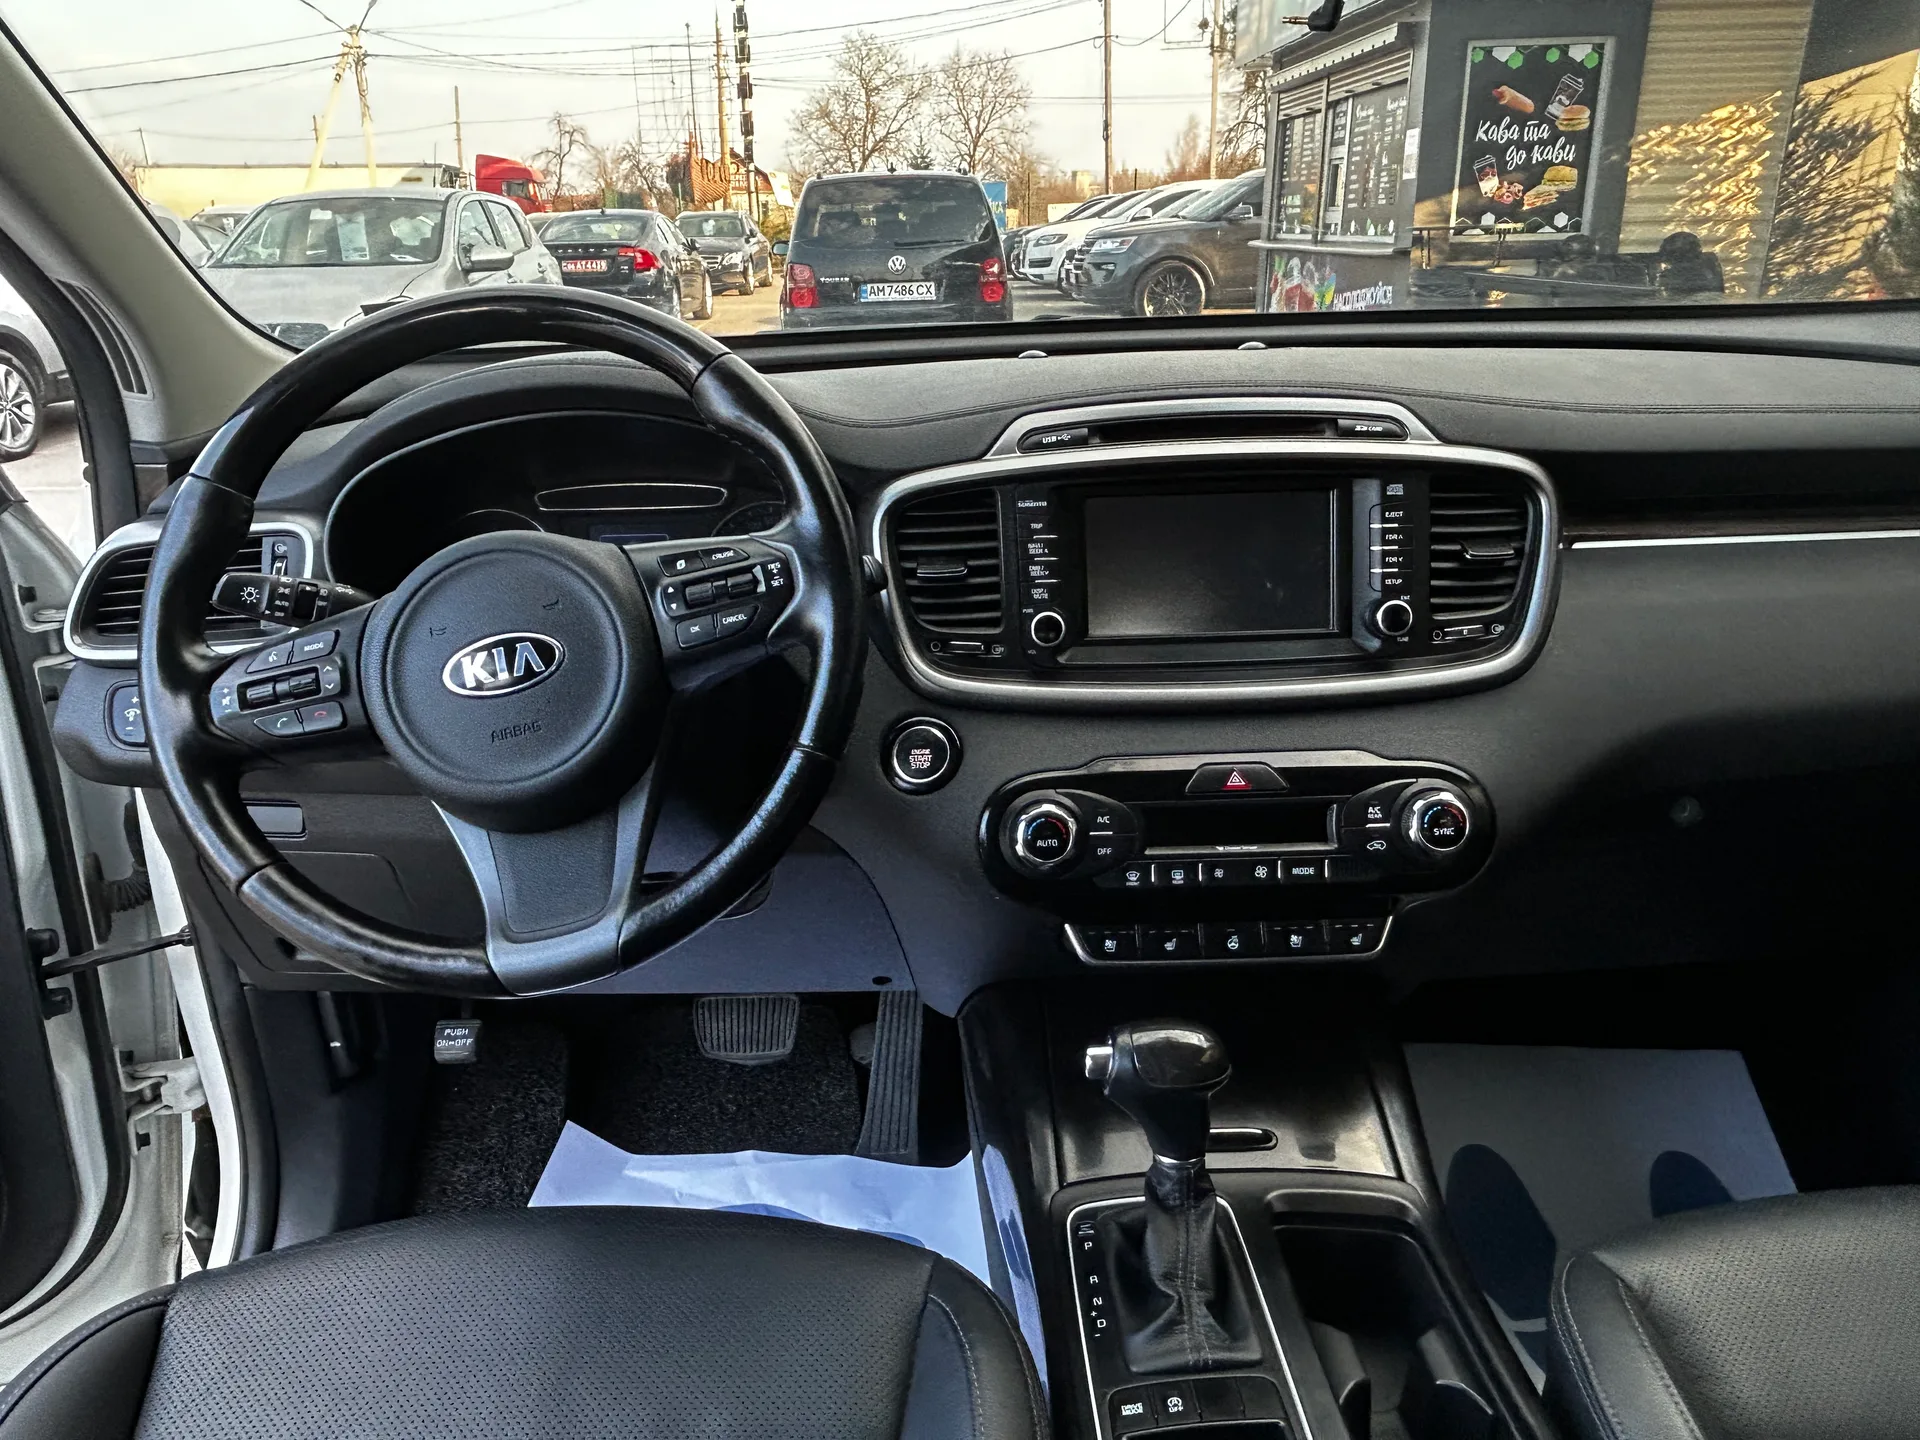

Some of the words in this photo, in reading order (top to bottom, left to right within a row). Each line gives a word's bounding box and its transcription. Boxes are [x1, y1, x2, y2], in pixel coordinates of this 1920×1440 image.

[1475, 116, 1520, 144] Кава
[1523, 120, 1551, 142] та
[1505, 145, 1527, 171] до
[1530, 136, 1576, 164] кави
[722, 613, 747, 624] CANCEL
[460, 641, 546, 689] KIA
[491, 721, 542, 744] AIRBAG
[909, 754, 932, 762] START
[911, 761, 930, 769] STOP
[1433, 827, 1455, 836] SYNC
[1036, 839, 1058, 847] AUTO
[1291, 867, 1315, 876] MODE
[444, 1028, 469, 1036] PUSH
[1084, 1241, 1092, 1250] P
[1090, 1275, 1098, 1284] R
[1093, 1296, 1102, 1306] N
[1097, 1318, 1106, 1328] D
